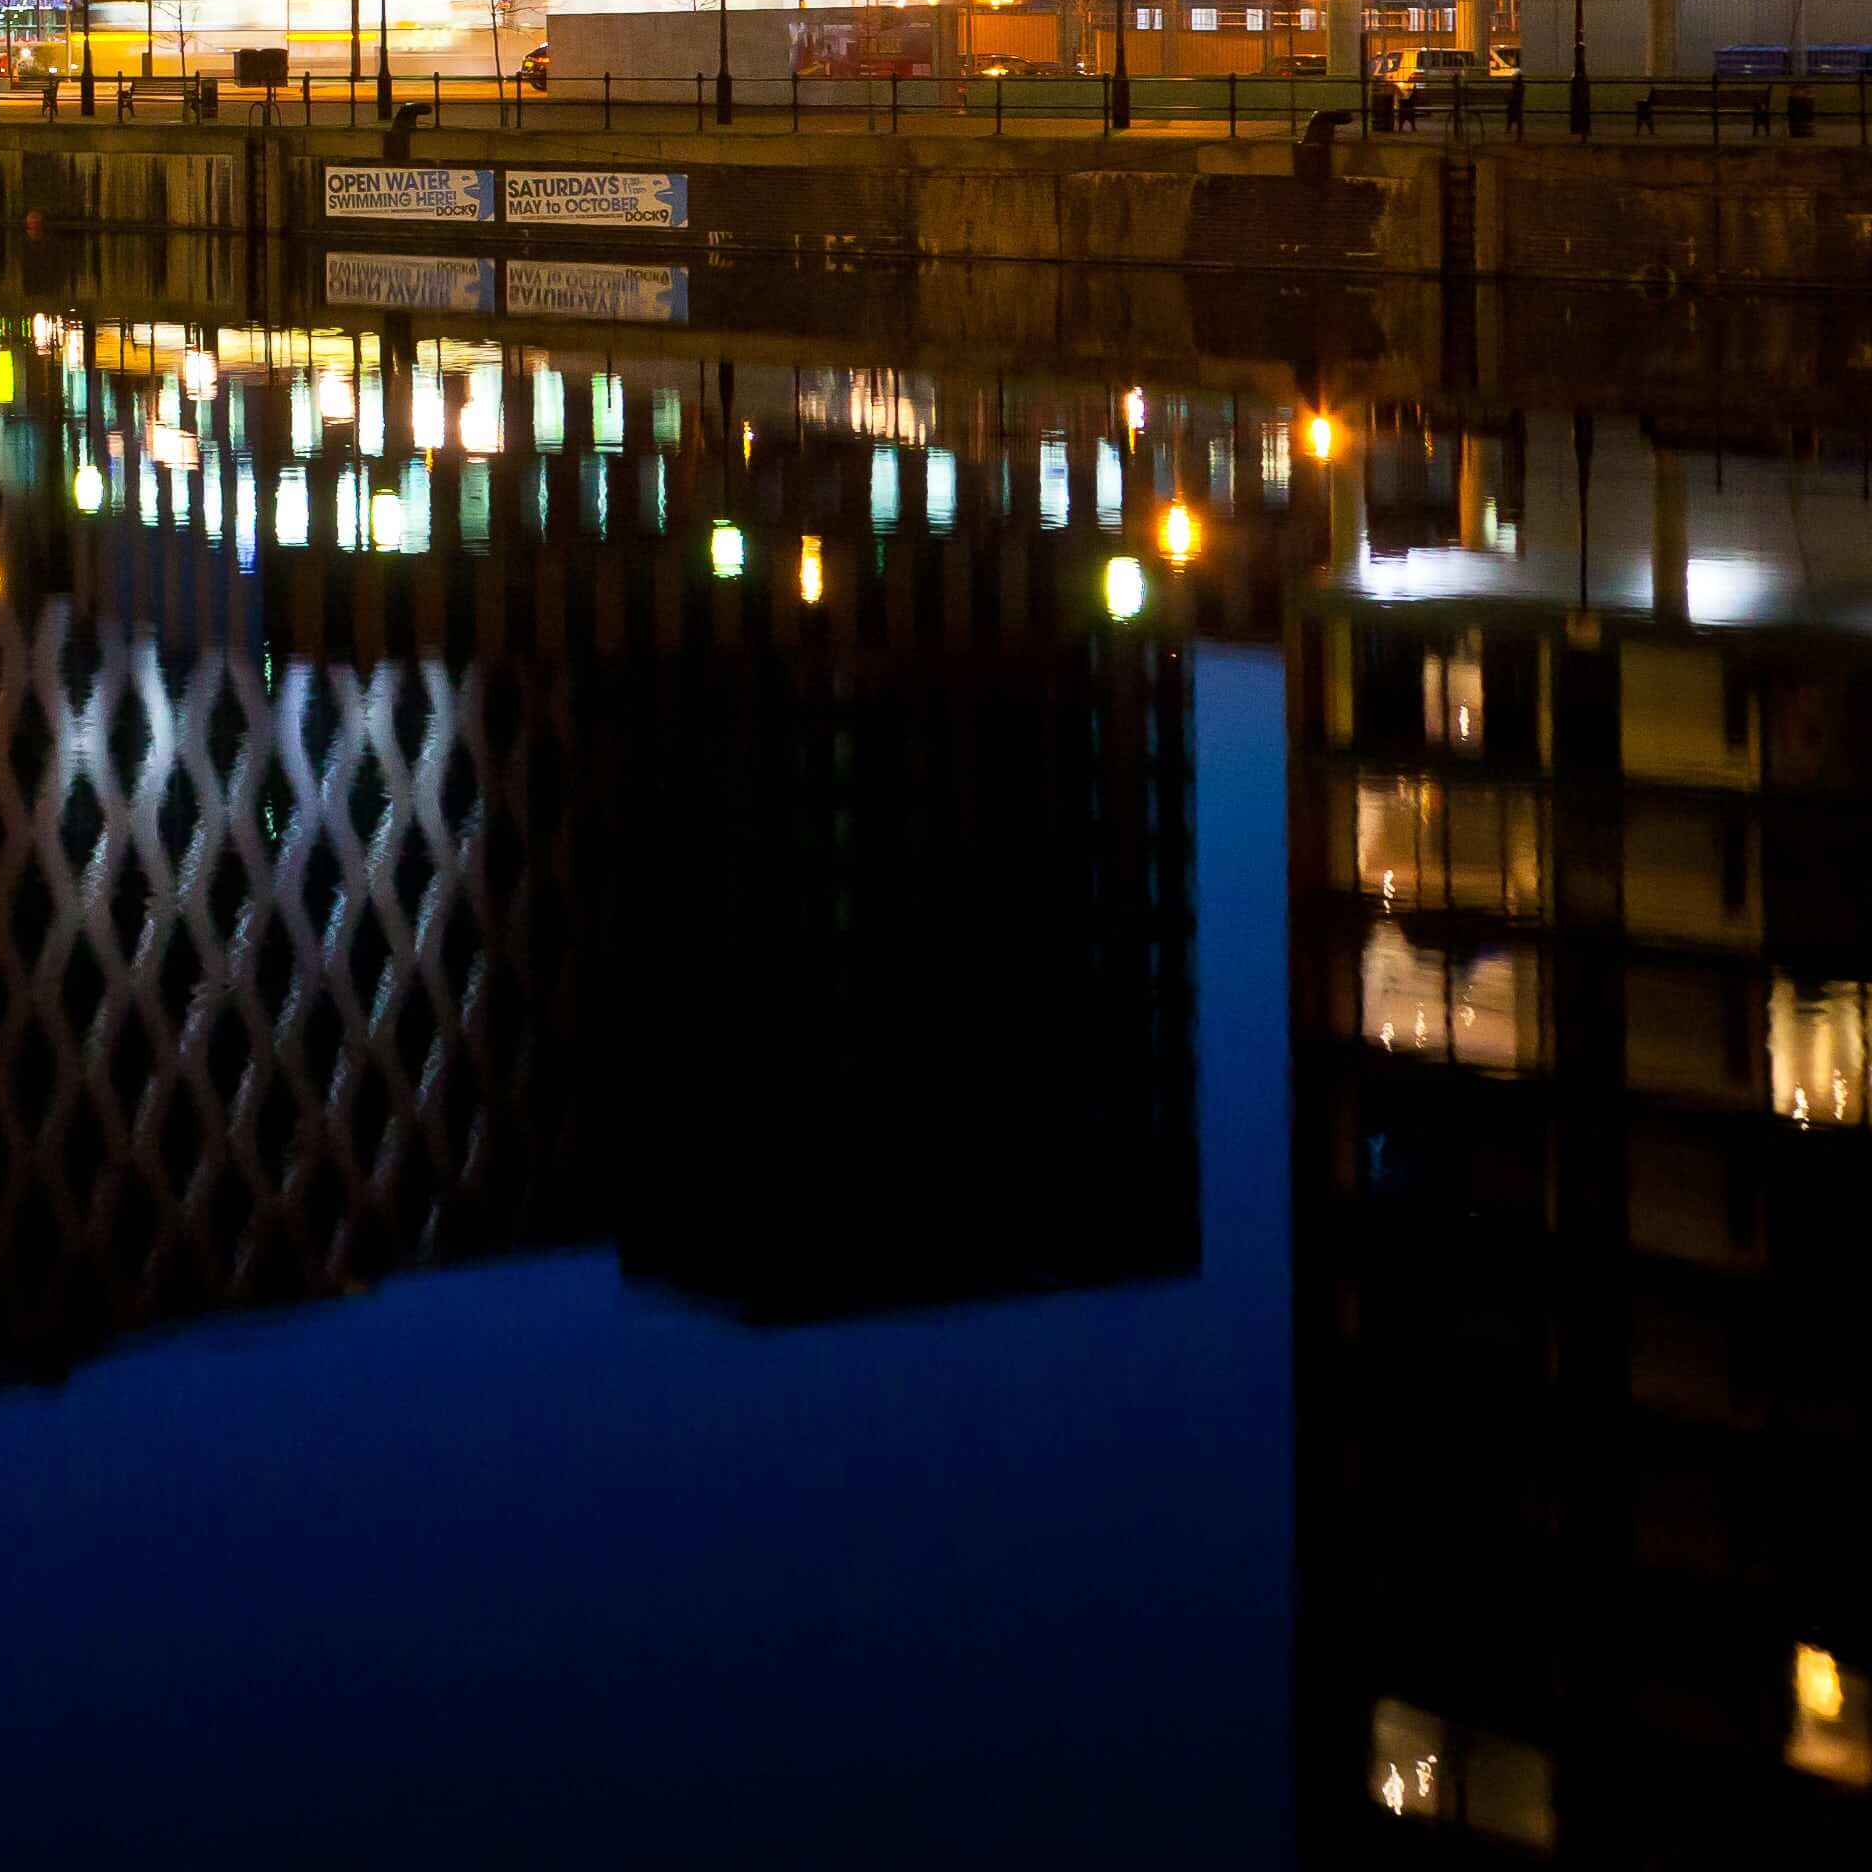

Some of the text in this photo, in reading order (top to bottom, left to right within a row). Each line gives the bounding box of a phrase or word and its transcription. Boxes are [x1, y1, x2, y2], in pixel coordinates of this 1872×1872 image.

[328, 171, 450, 193] OPEN WATER
[507, 175, 619, 198] SATURDAYS
[328, 191, 457, 209] SWIMMING HERE!
[509, 197, 639, 215] MAY to OCTOBER
[436, 204, 477, 218] DOCK9
[625, 208, 669, 223] DOCK9
